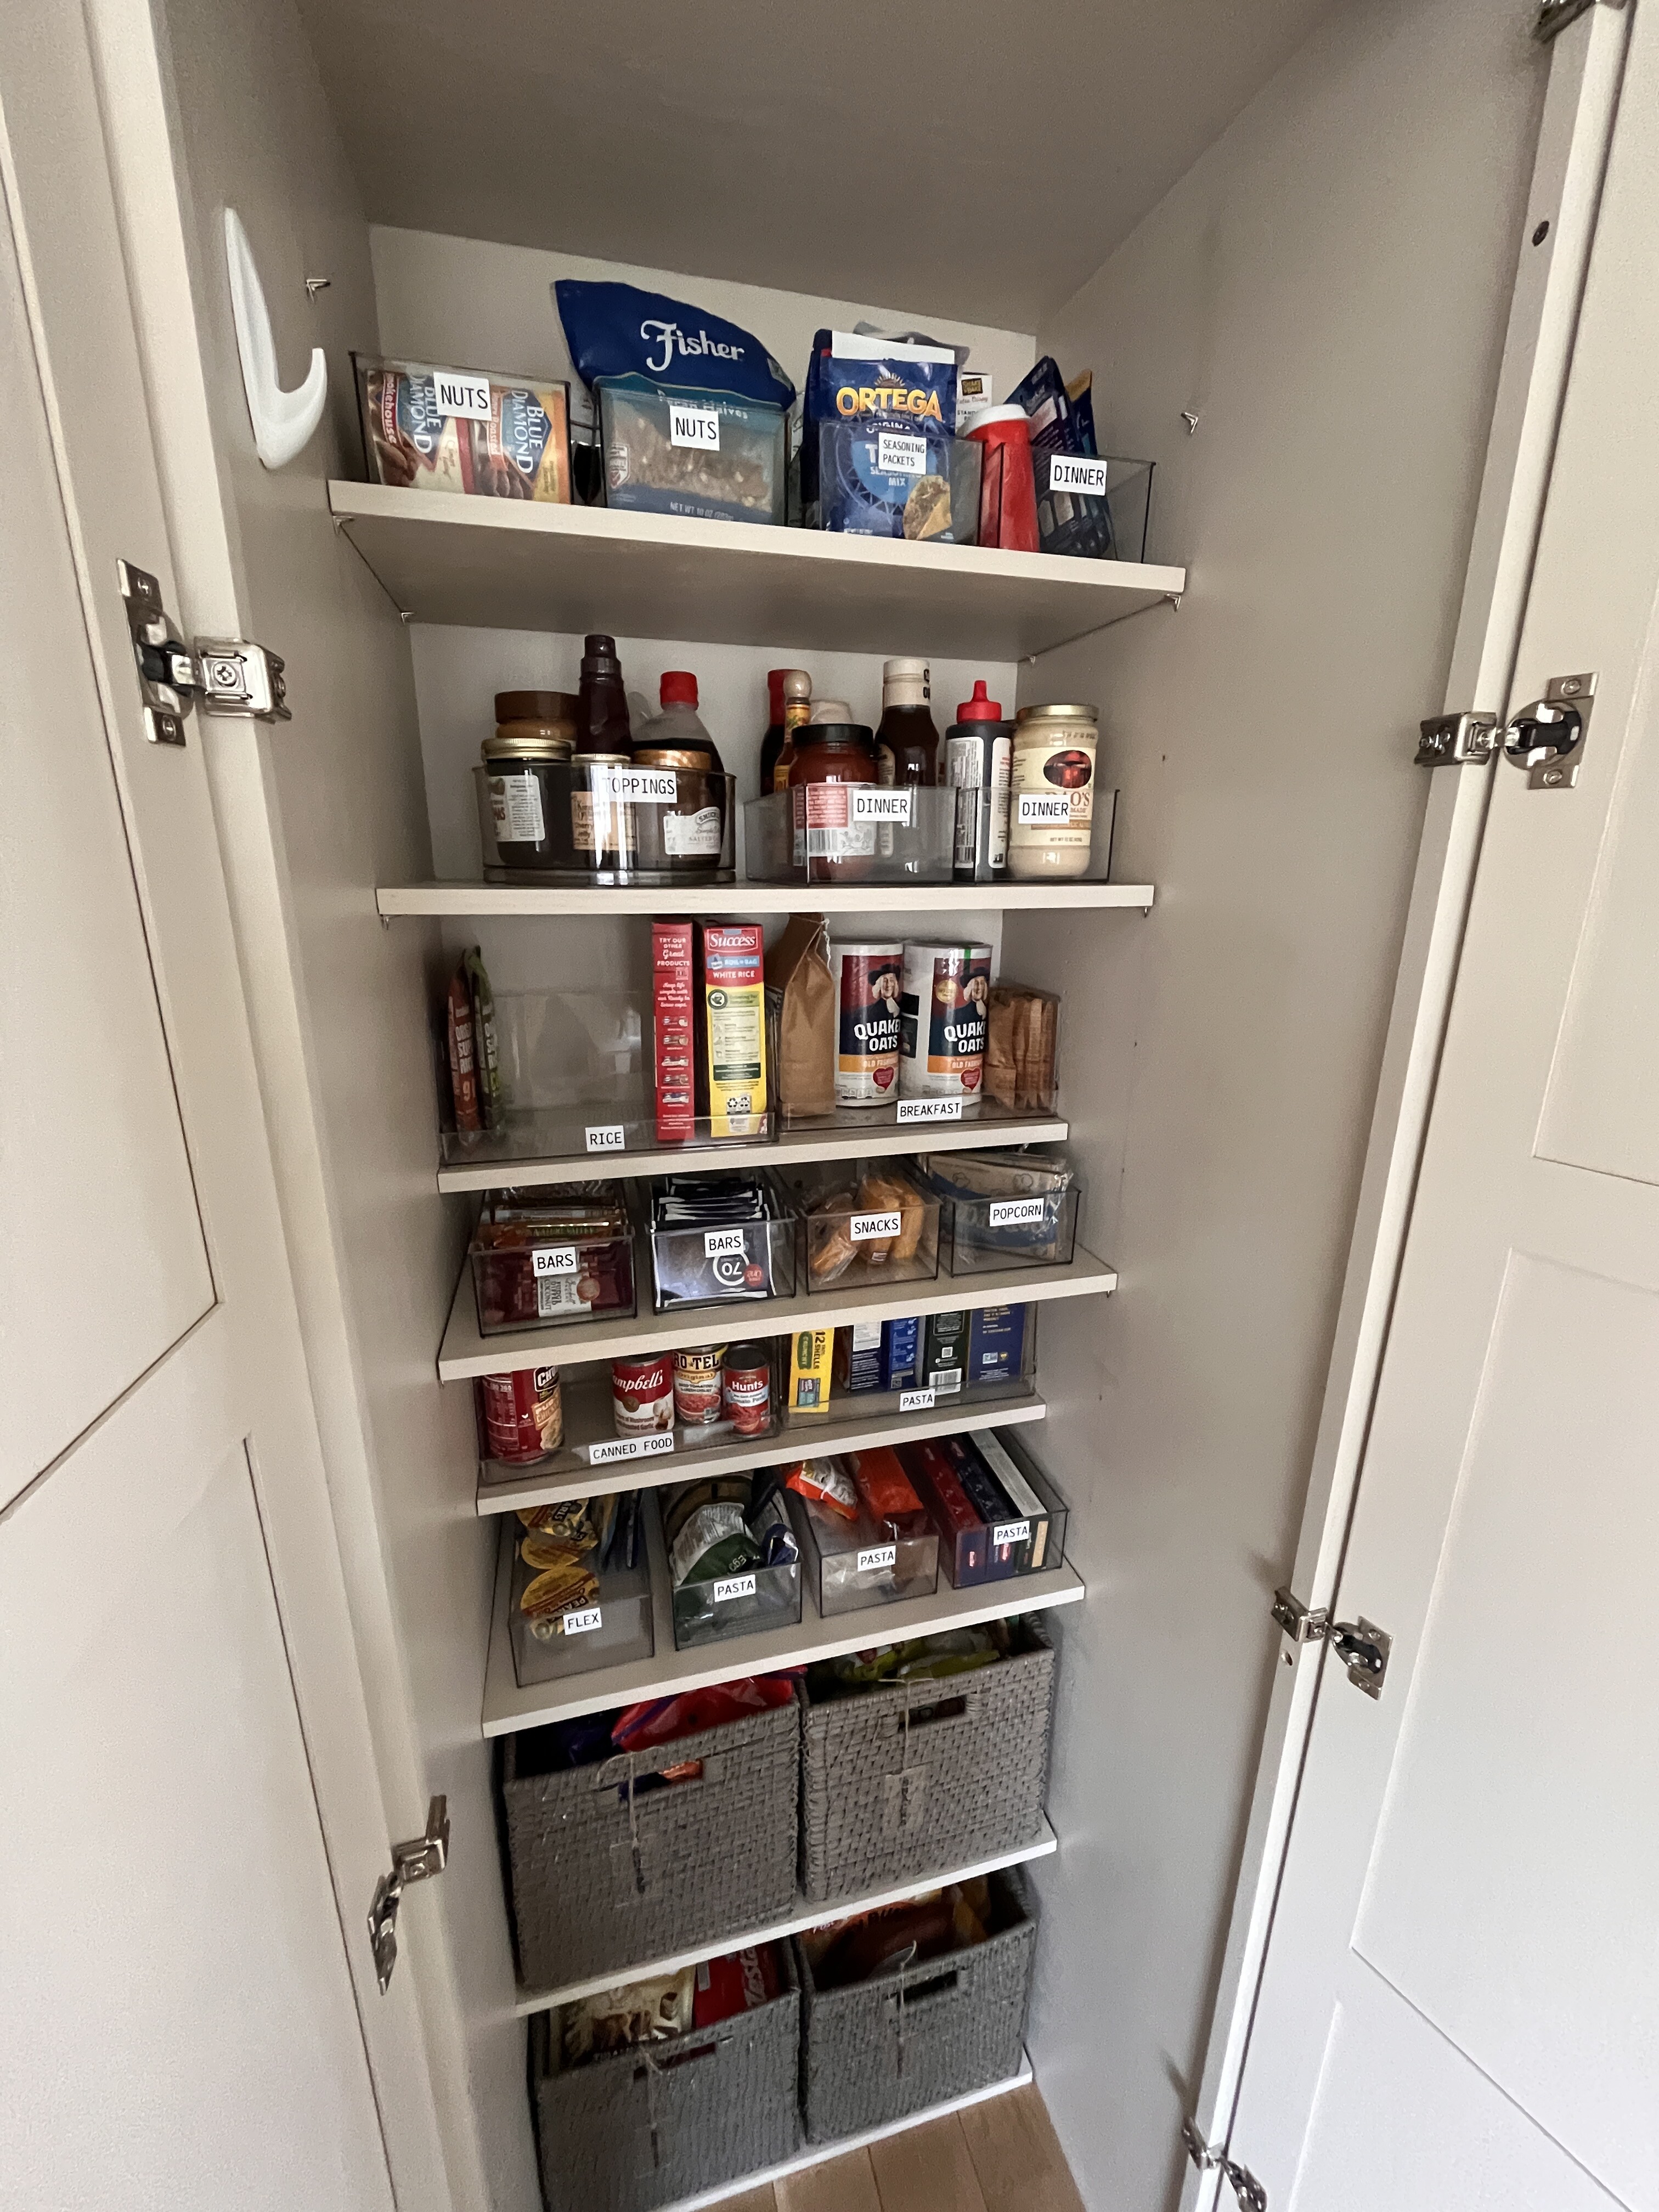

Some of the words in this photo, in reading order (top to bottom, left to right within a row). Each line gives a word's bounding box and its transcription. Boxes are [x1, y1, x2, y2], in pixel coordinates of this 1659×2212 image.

[640, 320, 744, 371] Fisher
[441, 384, 488, 409] NUTS
[836, 387, 943, 422] ORTEGA
[409, 371, 432, 454] DIAMOND
[511, 390, 534, 473] DIAMOND
[527, 405, 544, 449] BLUE
[676, 417, 716, 440] NUTS
[883, 439, 925, 454] SEASONING
[883, 454, 915, 467] PACKETS
[888, 477, 906, 487] MIX
[1054, 465, 1104, 486] DINNER
[857, 798, 907, 814] DINNER
[1022, 802, 1069, 816] DINNER
[709, 933, 755, 947] Success
[663, 949, 685, 960] Great
[854, 1019, 901, 1040] QUAKE
[944, 1021, 986, 1042] QUAK
[869, 1035, 898, 1051] OATS
[958, 1037, 984, 1053] OATS
[900, 1103, 961, 1118] BREAKFAST
[590, 1133, 623, 1145] RICE
[993, 1204, 1042, 1221] POPCORN
[855, 1218, 899, 1234] SNACKS
[709, 1236, 741, 1251] BARS
[537, 1254, 574, 1269] BARS
[815, 1331, 826, 1344] 12
[673, 1352, 687, 1369] RO
[692, 1354, 719, 1370] TEL
[813, 1344, 821, 1369] SHELLS
[613, 1369, 663, 1392] ampbell's
[902, 1395, 933, 1407] PASTA
[593, 1443, 637, 1459] CANNED
[644, 1437, 673, 1452] FOOD
[997, 1526, 1028, 1541] PASTA
[861, 1551, 894, 1566] PASTA
[717, 1580, 754, 1596] PASTA
[567, 1613, 599, 1629] FLEX
